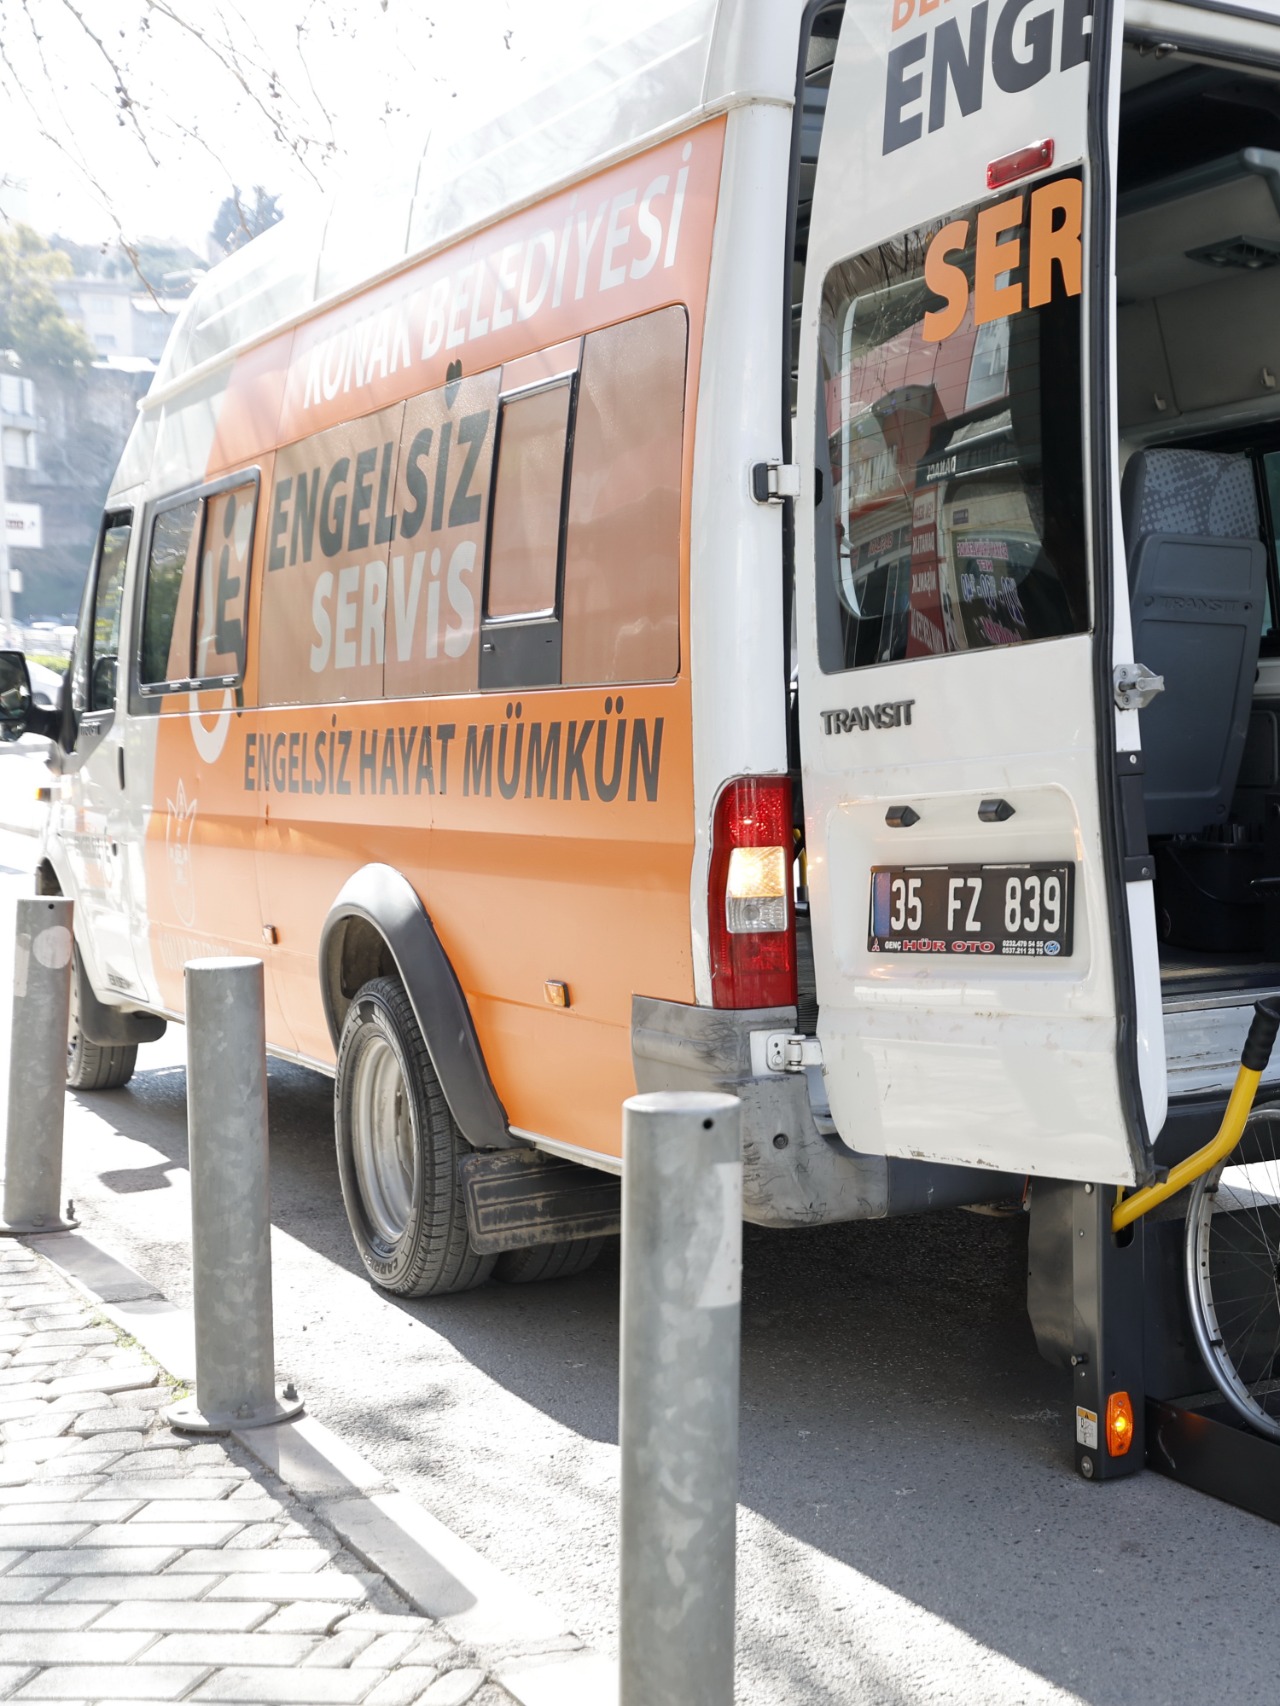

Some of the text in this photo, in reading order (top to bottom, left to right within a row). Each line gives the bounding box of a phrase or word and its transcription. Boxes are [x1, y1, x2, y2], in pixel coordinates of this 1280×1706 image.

[303, 141, 692, 408] KONAK BELEDİYESİ
[922, 178, 1083, 343] SER
[268, 359, 491, 572] ENGELSİZ
[244, 695, 665, 802] ENGELSİZ HAYAT MÜMKÜN
[820, 699, 916, 735] TRANSIT
[884, 937, 996, 953] GENÇ HÜR OTO
[890, 875, 1062, 933] 35 FZ 839
